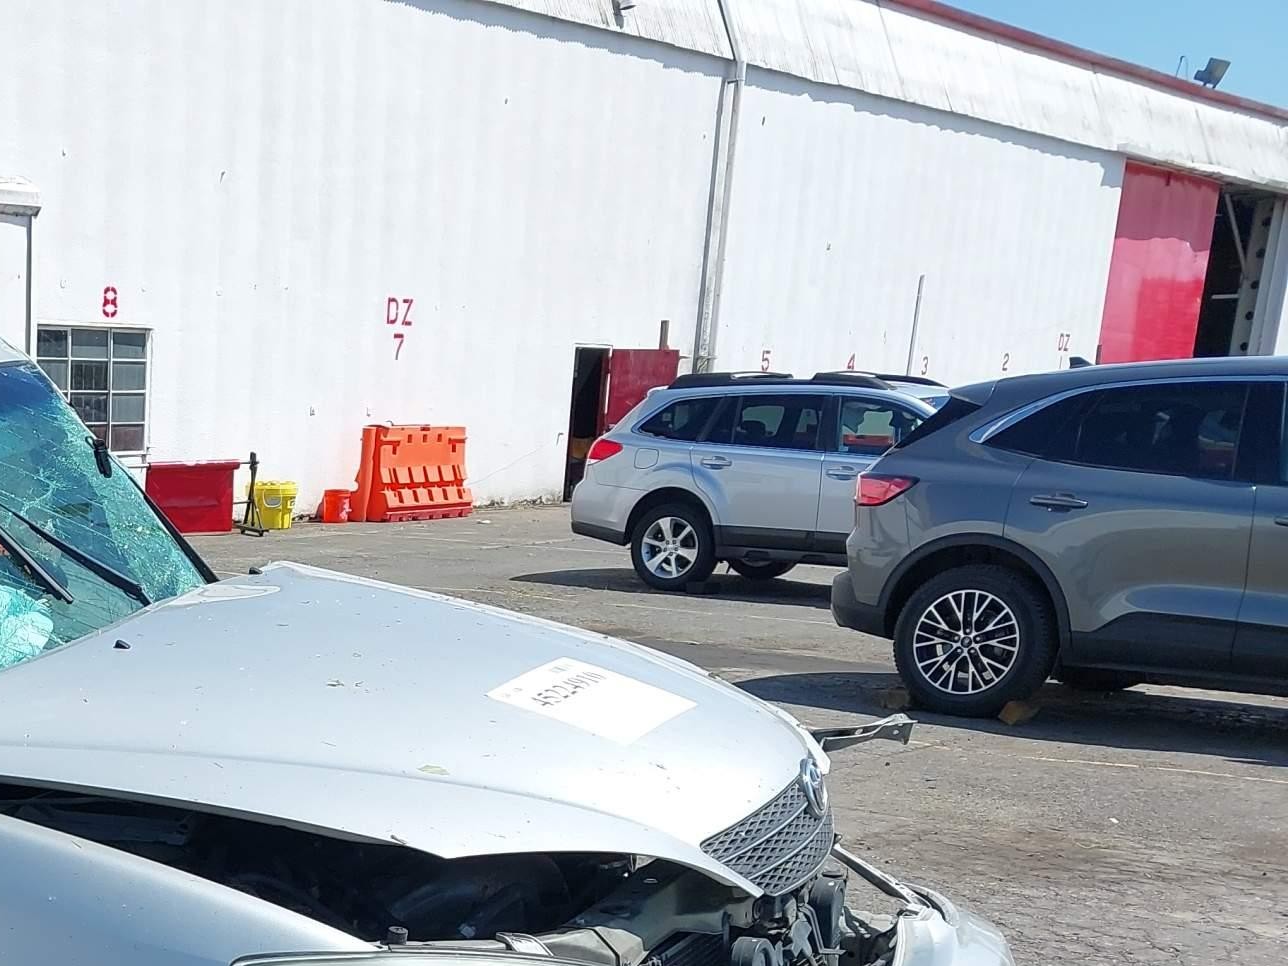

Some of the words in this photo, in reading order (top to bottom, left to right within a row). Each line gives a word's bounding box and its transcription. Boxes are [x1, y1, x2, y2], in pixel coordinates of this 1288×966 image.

[102, 286, 118, 318] 8
[386, 297, 413, 326] DZ
[393, 333, 404, 361] 7
[761, 350, 771, 372] 5
[847, 353, 856, 371] 4
[921, 356, 929, 375] 3
[1001, 353, 1010, 371] 2
